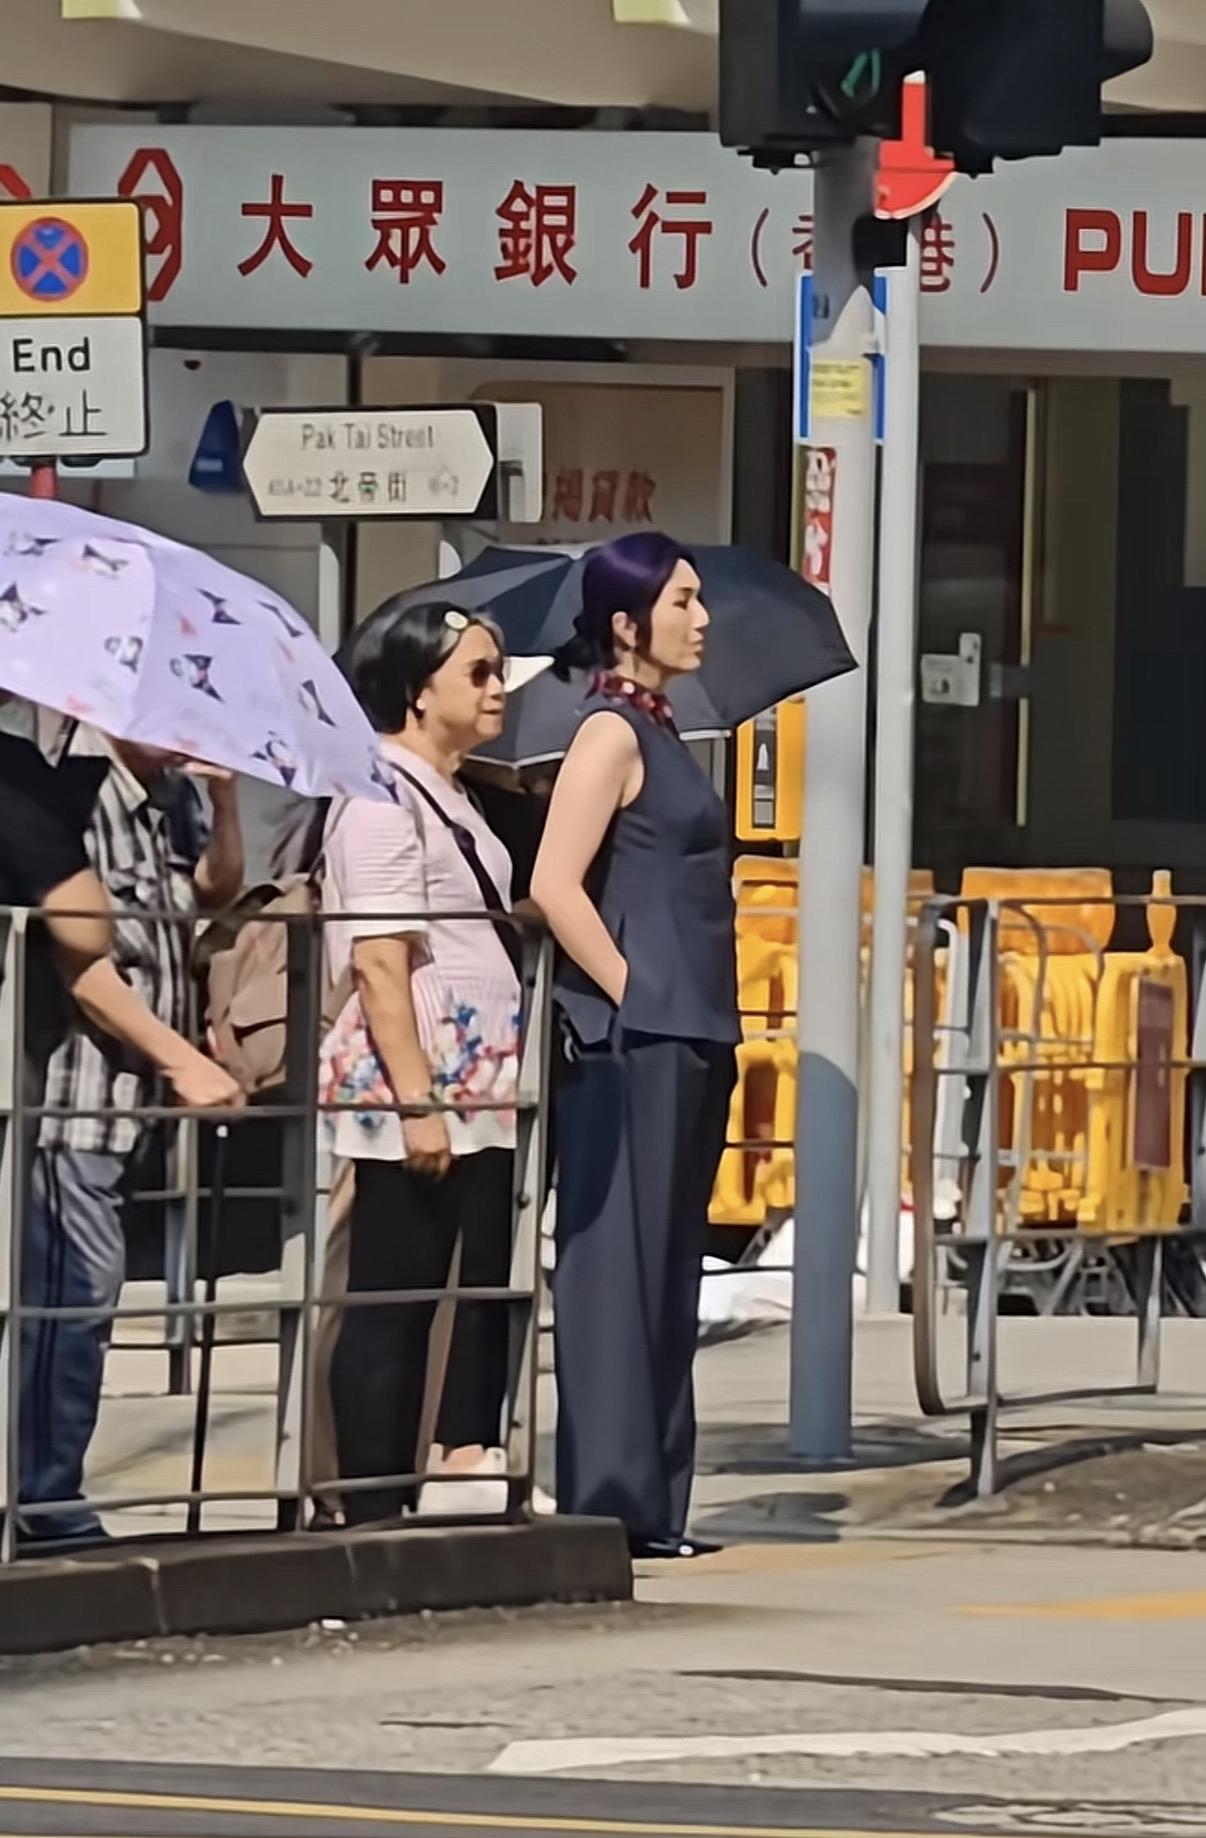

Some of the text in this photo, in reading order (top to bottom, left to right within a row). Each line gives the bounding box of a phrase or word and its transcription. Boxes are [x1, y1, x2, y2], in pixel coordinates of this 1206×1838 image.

[1064, 208, 1206, 297] PU
[13, 336, 90, 372] End
[0, 390, 107, 441] 終止
[302, 423, 434, 450] Pak Tai Street
